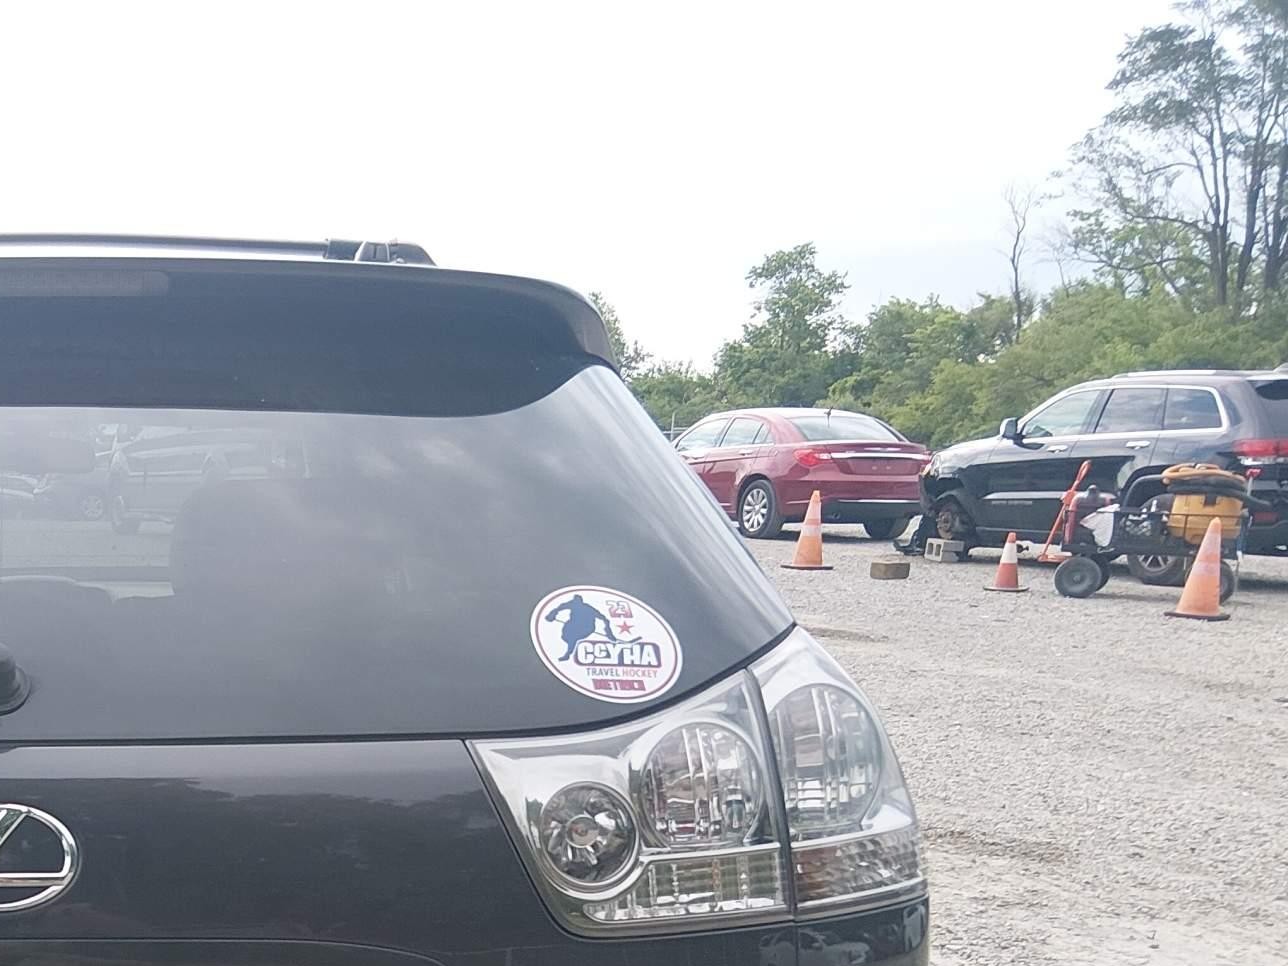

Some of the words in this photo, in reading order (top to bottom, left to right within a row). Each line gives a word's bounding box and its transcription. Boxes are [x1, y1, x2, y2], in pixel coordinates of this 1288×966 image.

[576, 642, 658, 666] CCYHA
[586, 667, 621, 678] TRAVEL
[622, 668, 658, 679] HOCKEY
